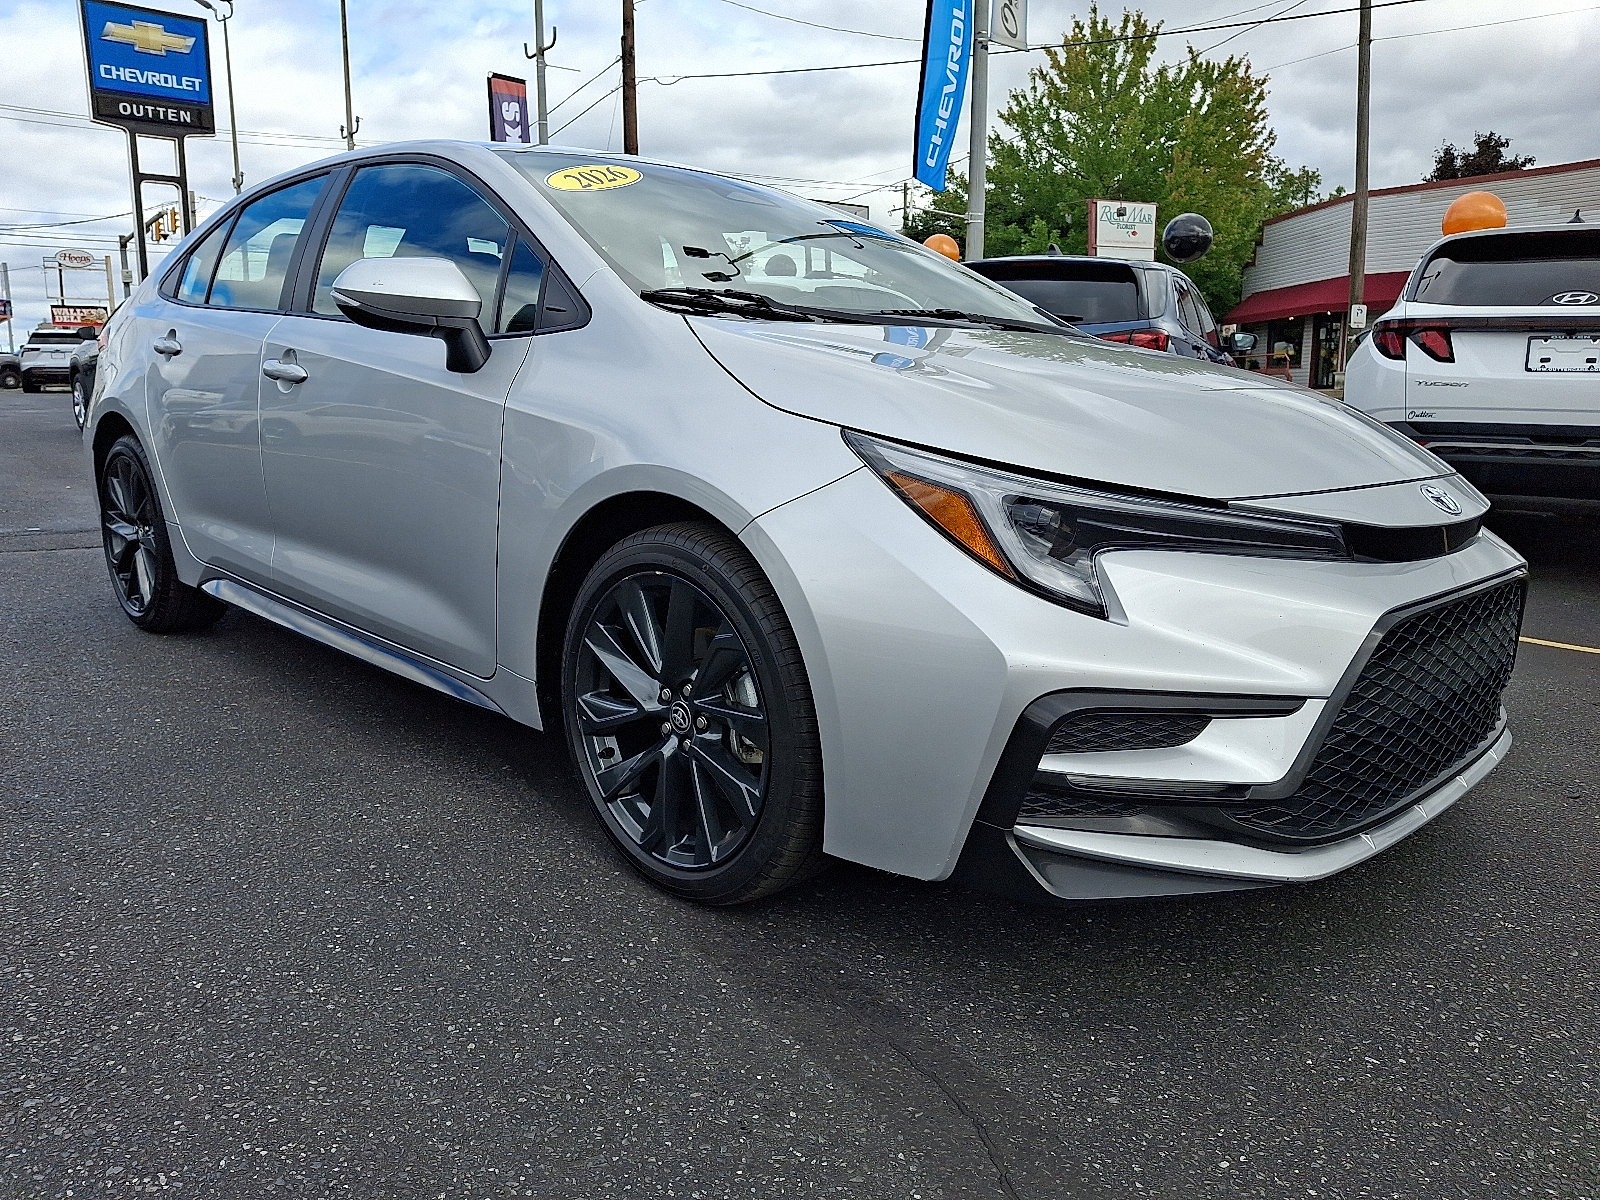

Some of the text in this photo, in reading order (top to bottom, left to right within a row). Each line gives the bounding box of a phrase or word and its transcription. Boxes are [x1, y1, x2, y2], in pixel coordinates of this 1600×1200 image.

[100, 64, 202, 91] CHEVROLET
[118, 102, 191, 123] OUTTEN
[564, 166, 629, 189] 2026
[1407, 410, 1437, 419] Outten
